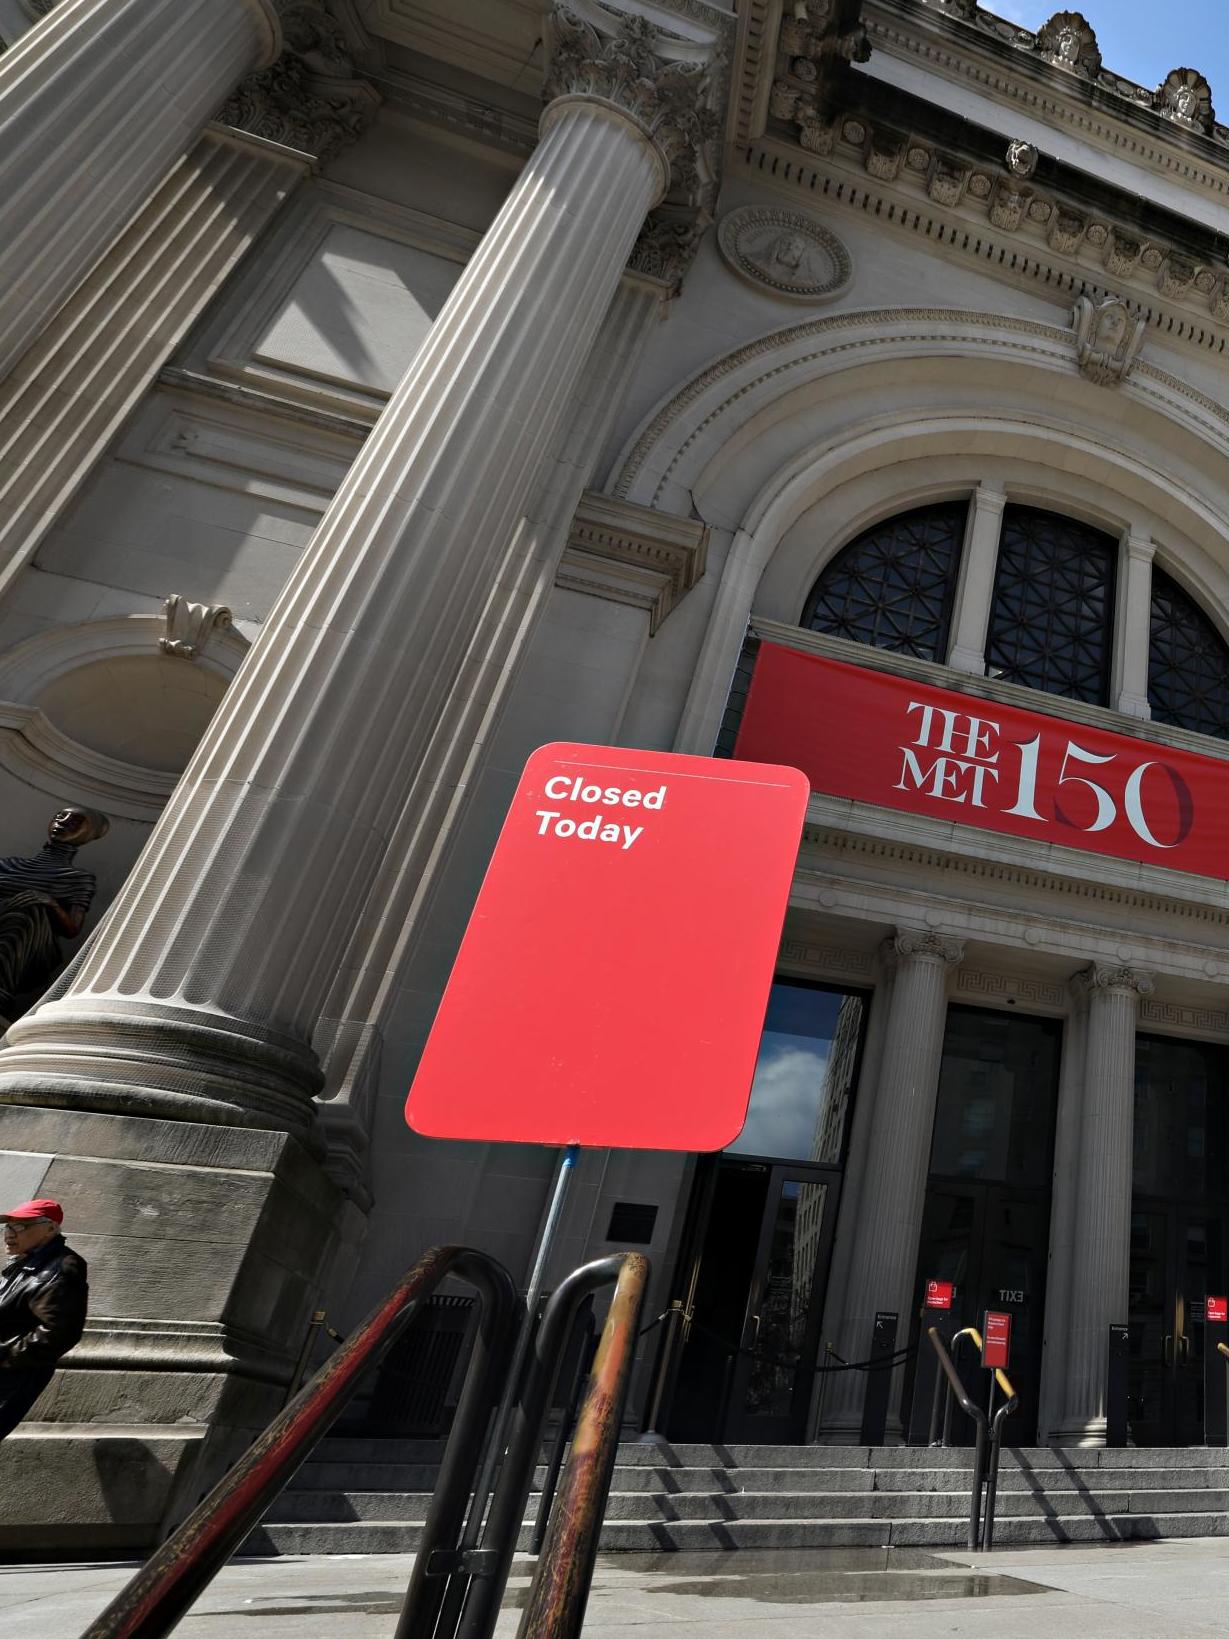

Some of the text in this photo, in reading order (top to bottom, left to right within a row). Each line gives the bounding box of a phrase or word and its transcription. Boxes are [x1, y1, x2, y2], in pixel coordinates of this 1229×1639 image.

[906, 701, 1000, 764] THE
[544, 776, 667, 810] Closed
[892, 746, 999, 809] MET
[1001, 732, 1194, 848] 150
[535, 810, 644, 850] Today
